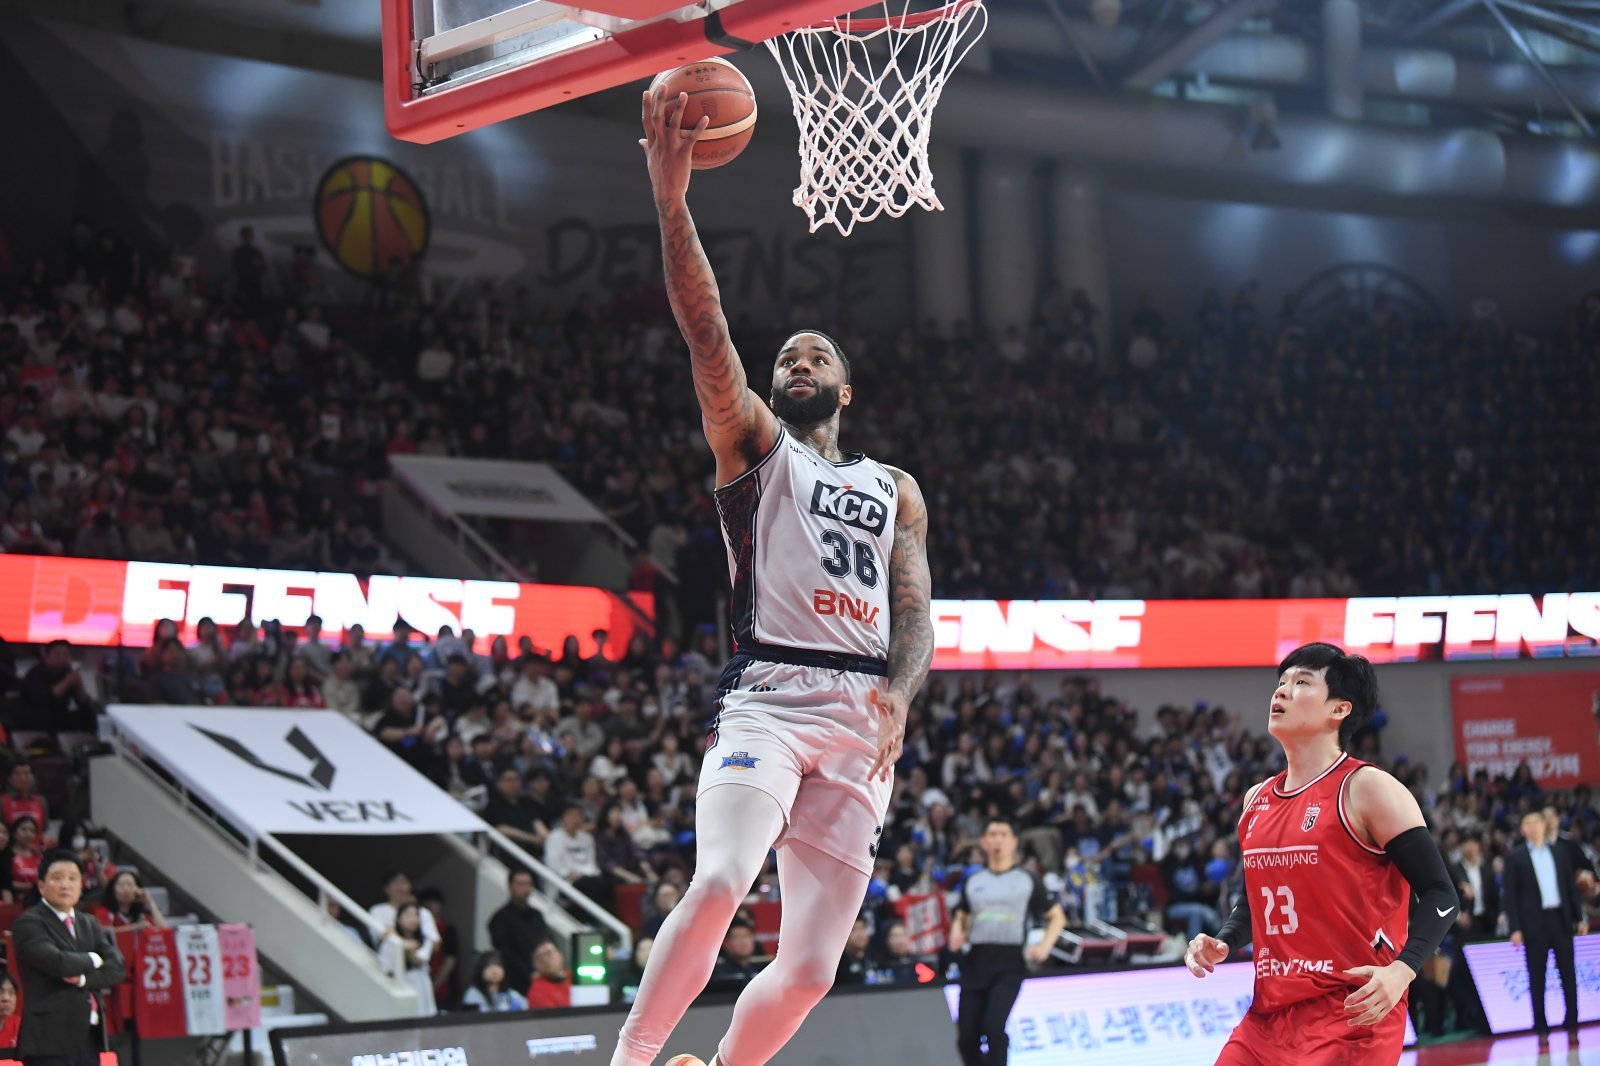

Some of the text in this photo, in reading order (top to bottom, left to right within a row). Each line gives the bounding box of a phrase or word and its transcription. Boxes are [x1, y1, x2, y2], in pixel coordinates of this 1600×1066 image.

[538, 216, 899, 299] DEENSE
[817, 485, 883, 528] KCC
[820, 529, 879, 590] 36
[930, 599, 1146, 668] ENSE
[1243, 852, 1318, 870] NGKWANJANG
[1261, 885, 1299, 935] 23
[144, 955, 171, 989] 23
[187, 955, 211, 986] 23
[222, 955, 249, 979] 23
